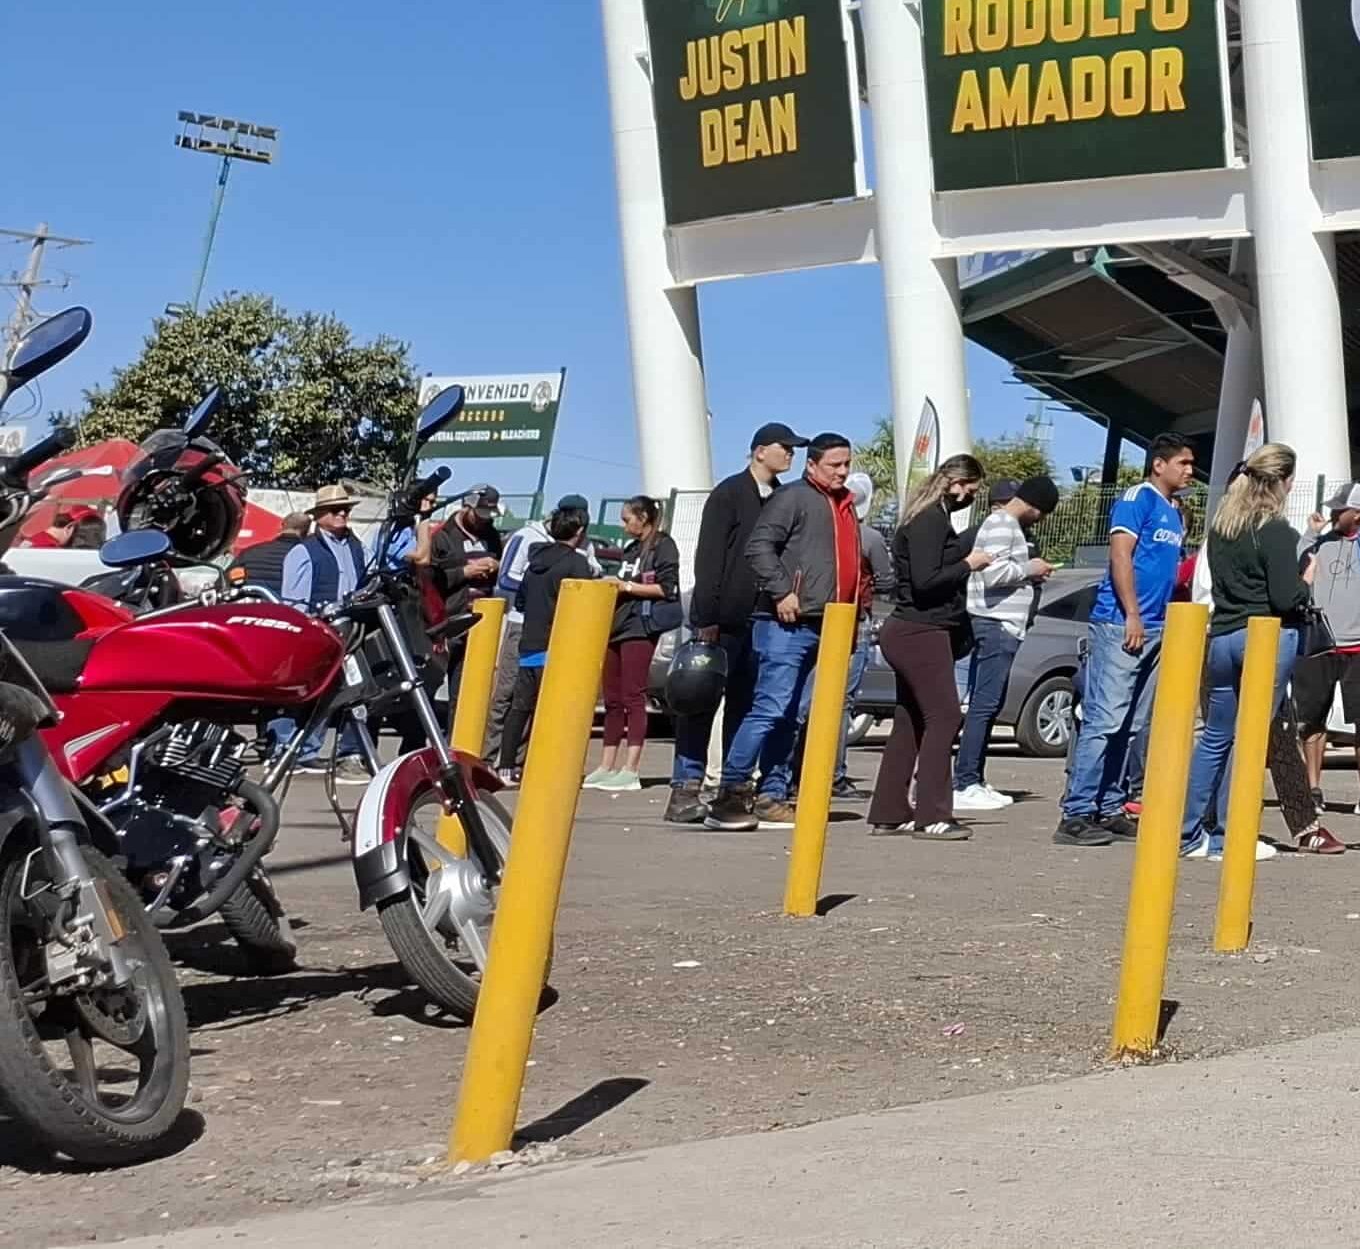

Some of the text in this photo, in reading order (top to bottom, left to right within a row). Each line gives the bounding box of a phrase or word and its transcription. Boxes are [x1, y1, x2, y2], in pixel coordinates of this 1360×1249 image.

[679, 15, 807, 101] JUSTIN
[951, 46, 1186, 133] AMADOR
[700, 92, 797, 168] DEAN
[464, 383, 530, 402] NVENIDO
